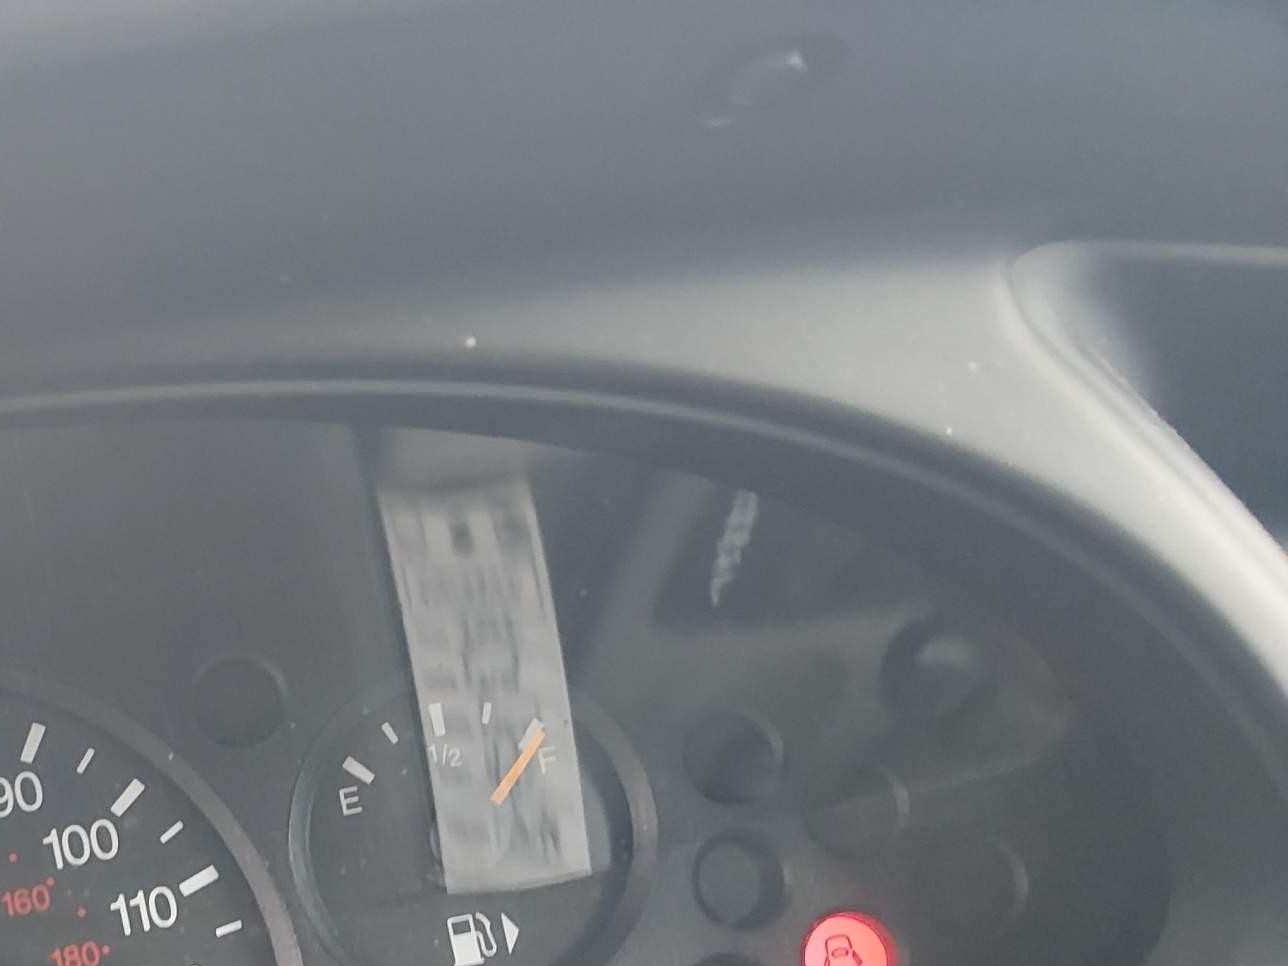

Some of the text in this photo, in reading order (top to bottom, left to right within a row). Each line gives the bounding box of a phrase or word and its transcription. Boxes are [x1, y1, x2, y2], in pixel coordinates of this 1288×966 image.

[428, 745, 463, 769] 1/2
[538, 746, 557, 775] F
[339, 786, 362, 816] E
[42, 819, 119, 870] 100
[1, 884, 51, 917] 160
[110, 886, 178, 936] 110
